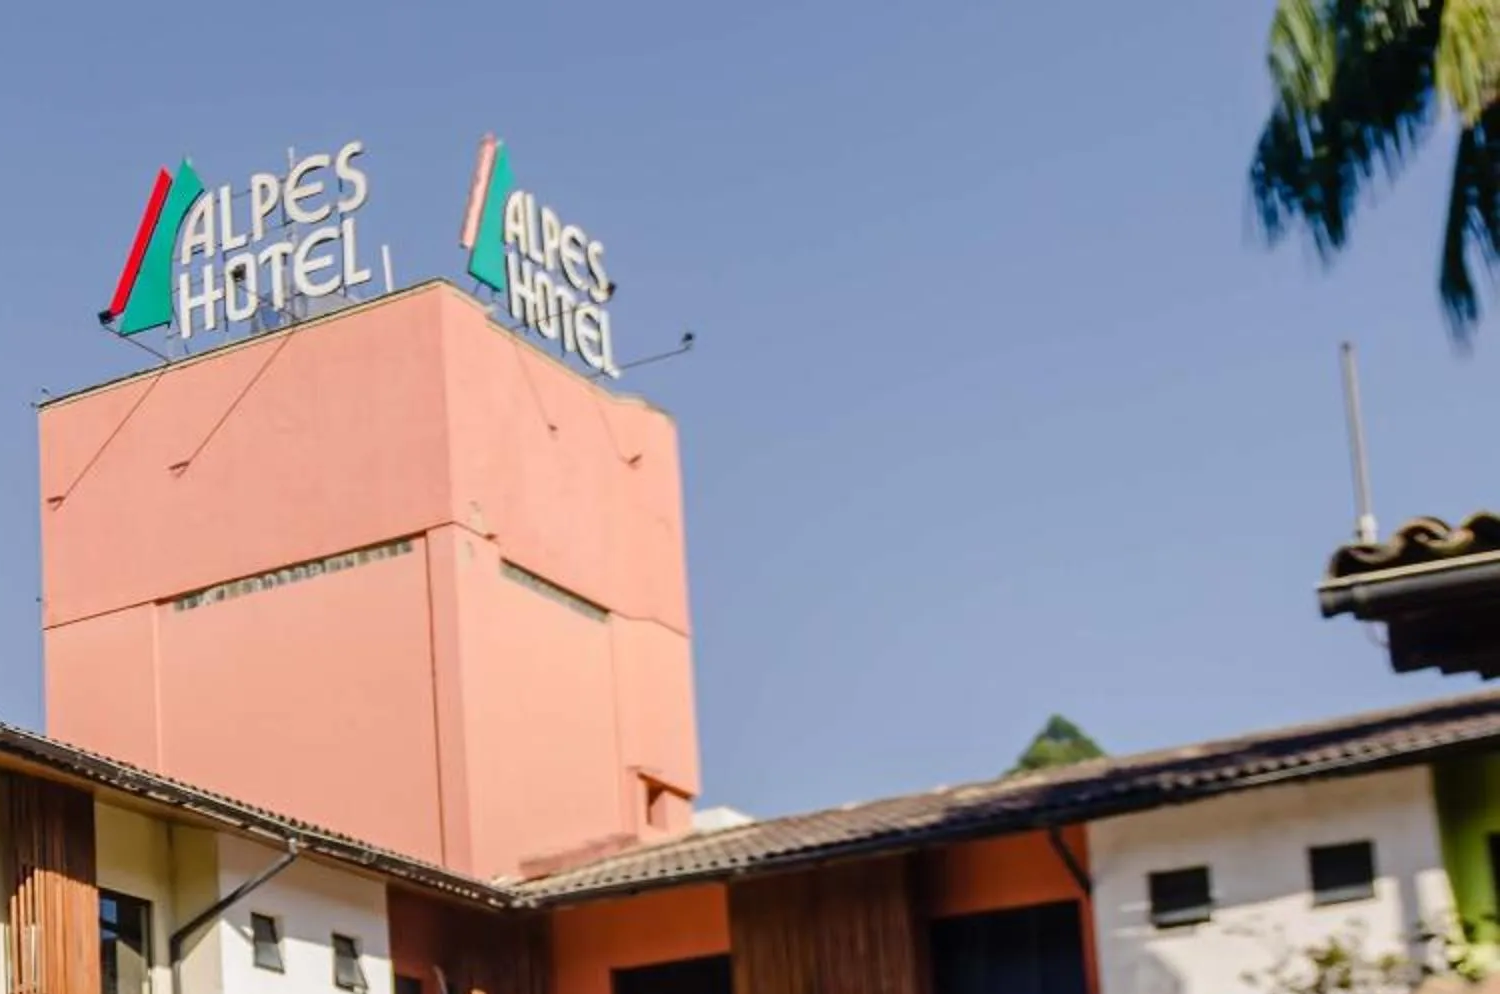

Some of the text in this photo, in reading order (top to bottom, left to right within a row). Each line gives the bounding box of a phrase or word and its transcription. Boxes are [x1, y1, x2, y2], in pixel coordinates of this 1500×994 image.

[180, 141, 369, 265] ALPES
[504, 190, 613, 302] ALPES
[177, 218, 372, 339] HOTEL
[505, 253, 620, 379] HOTEL
